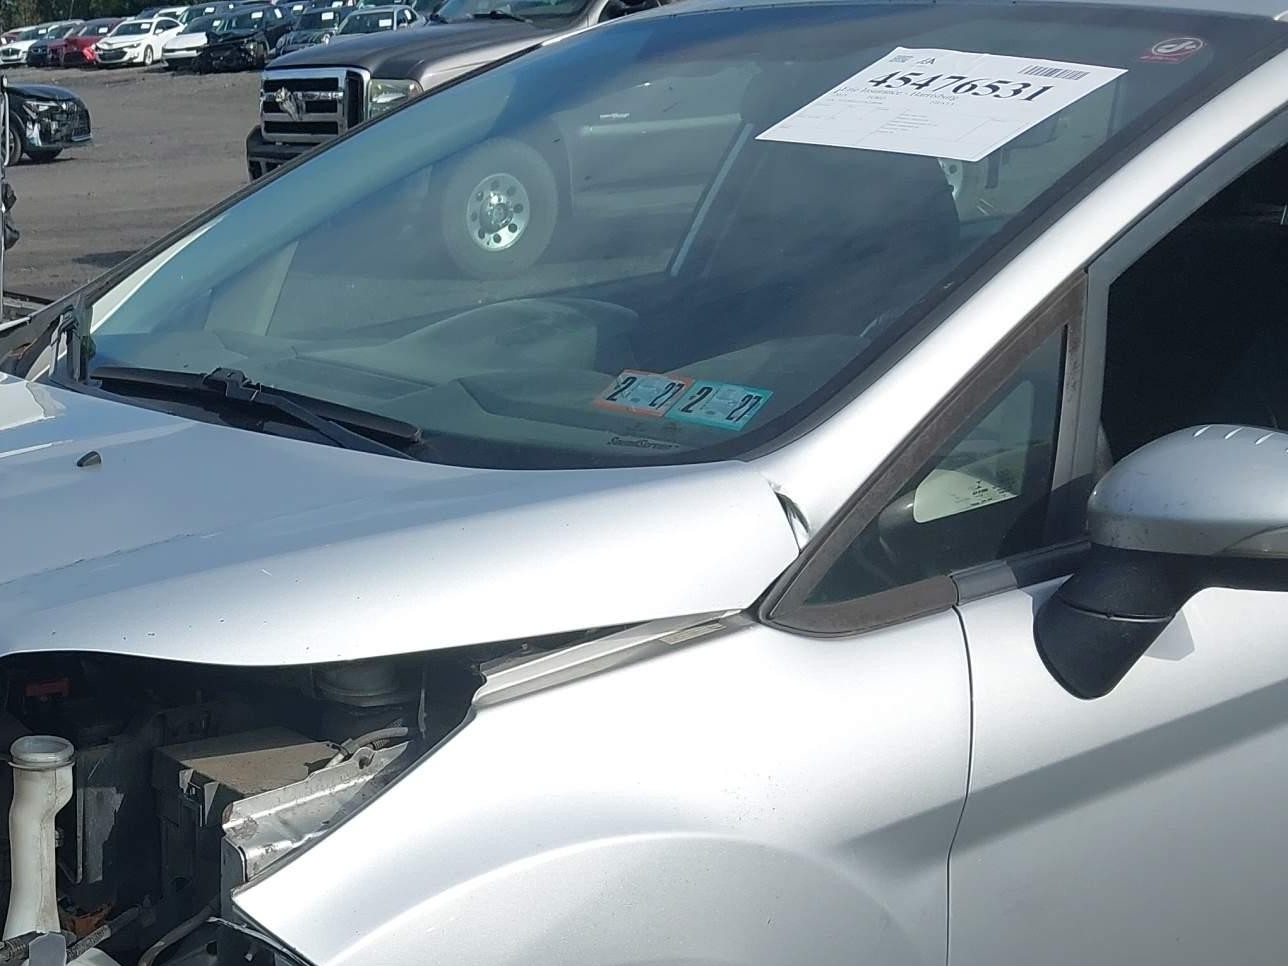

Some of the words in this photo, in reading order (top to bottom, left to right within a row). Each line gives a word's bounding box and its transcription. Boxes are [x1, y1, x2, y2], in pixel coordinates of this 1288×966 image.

[868, 70, 1055, 101] 45476531
[606, 376, 637, 402] 2
[649, 382, 685, 410] 27
[681, 386, 713, 414] 2
[725, 394, 763, 422] 27
